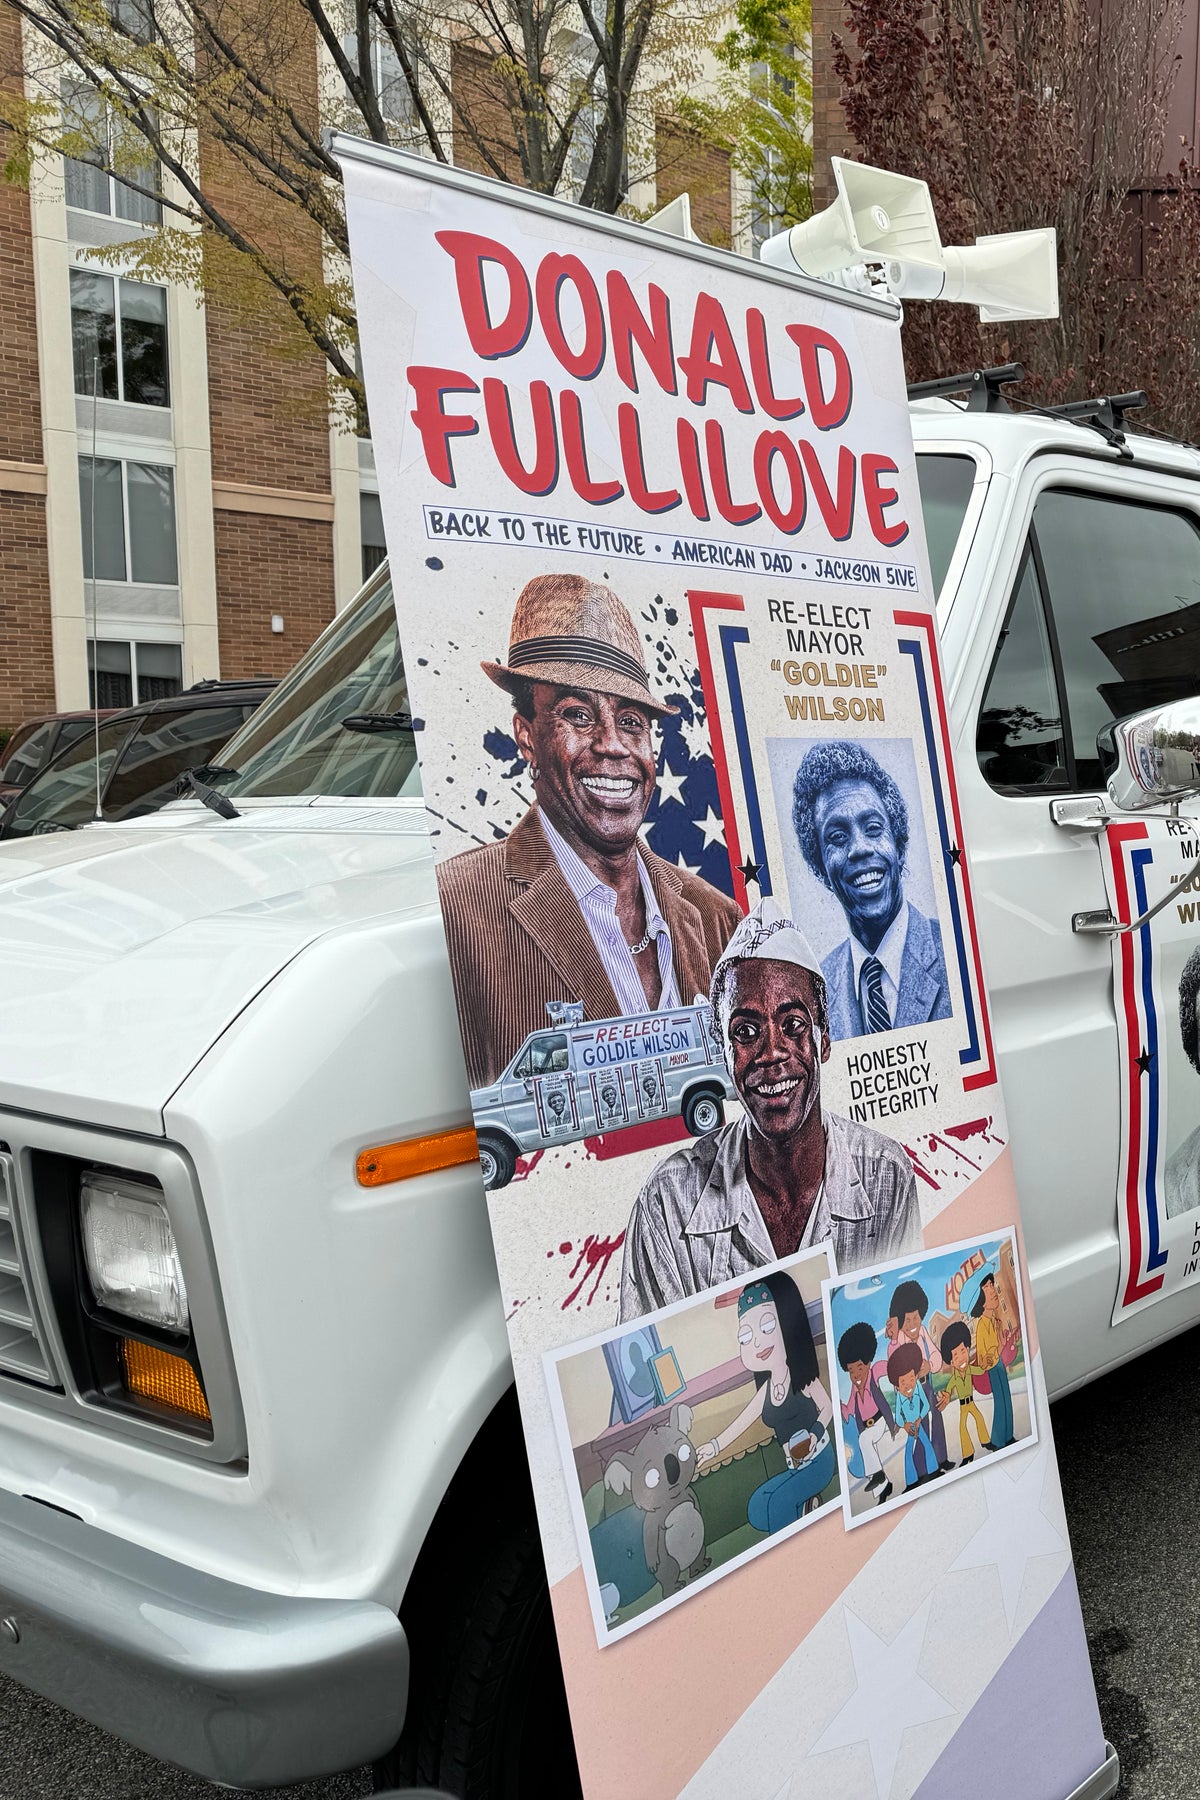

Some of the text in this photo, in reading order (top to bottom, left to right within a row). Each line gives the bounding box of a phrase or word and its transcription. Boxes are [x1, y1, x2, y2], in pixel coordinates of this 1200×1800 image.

[434, 230, 853, 432] DONALD
[406, 366, 910, 547] FULLILOVE
[428, 510, 916, 587] BACK TO THE FUTURE AMERICAN DAD JACKSON 5IVE
[767, 598, 872, 630] RE-ELECT
[786, 628, 865, 656] MAYOR
[770, 659, 887, 688] “GOLDIE”
[784, 695, 886, 721] WILSON
[583, 1030, 690, 1066] GOLDIE WILSON
[669, 1053, 689, 1066] MAYOR
[847, 1040, 927, 1077] HONESTY
[850, 1062, 931, 1101] DECENCY
[849, 1084, 939, 1123] INTEGRITY
